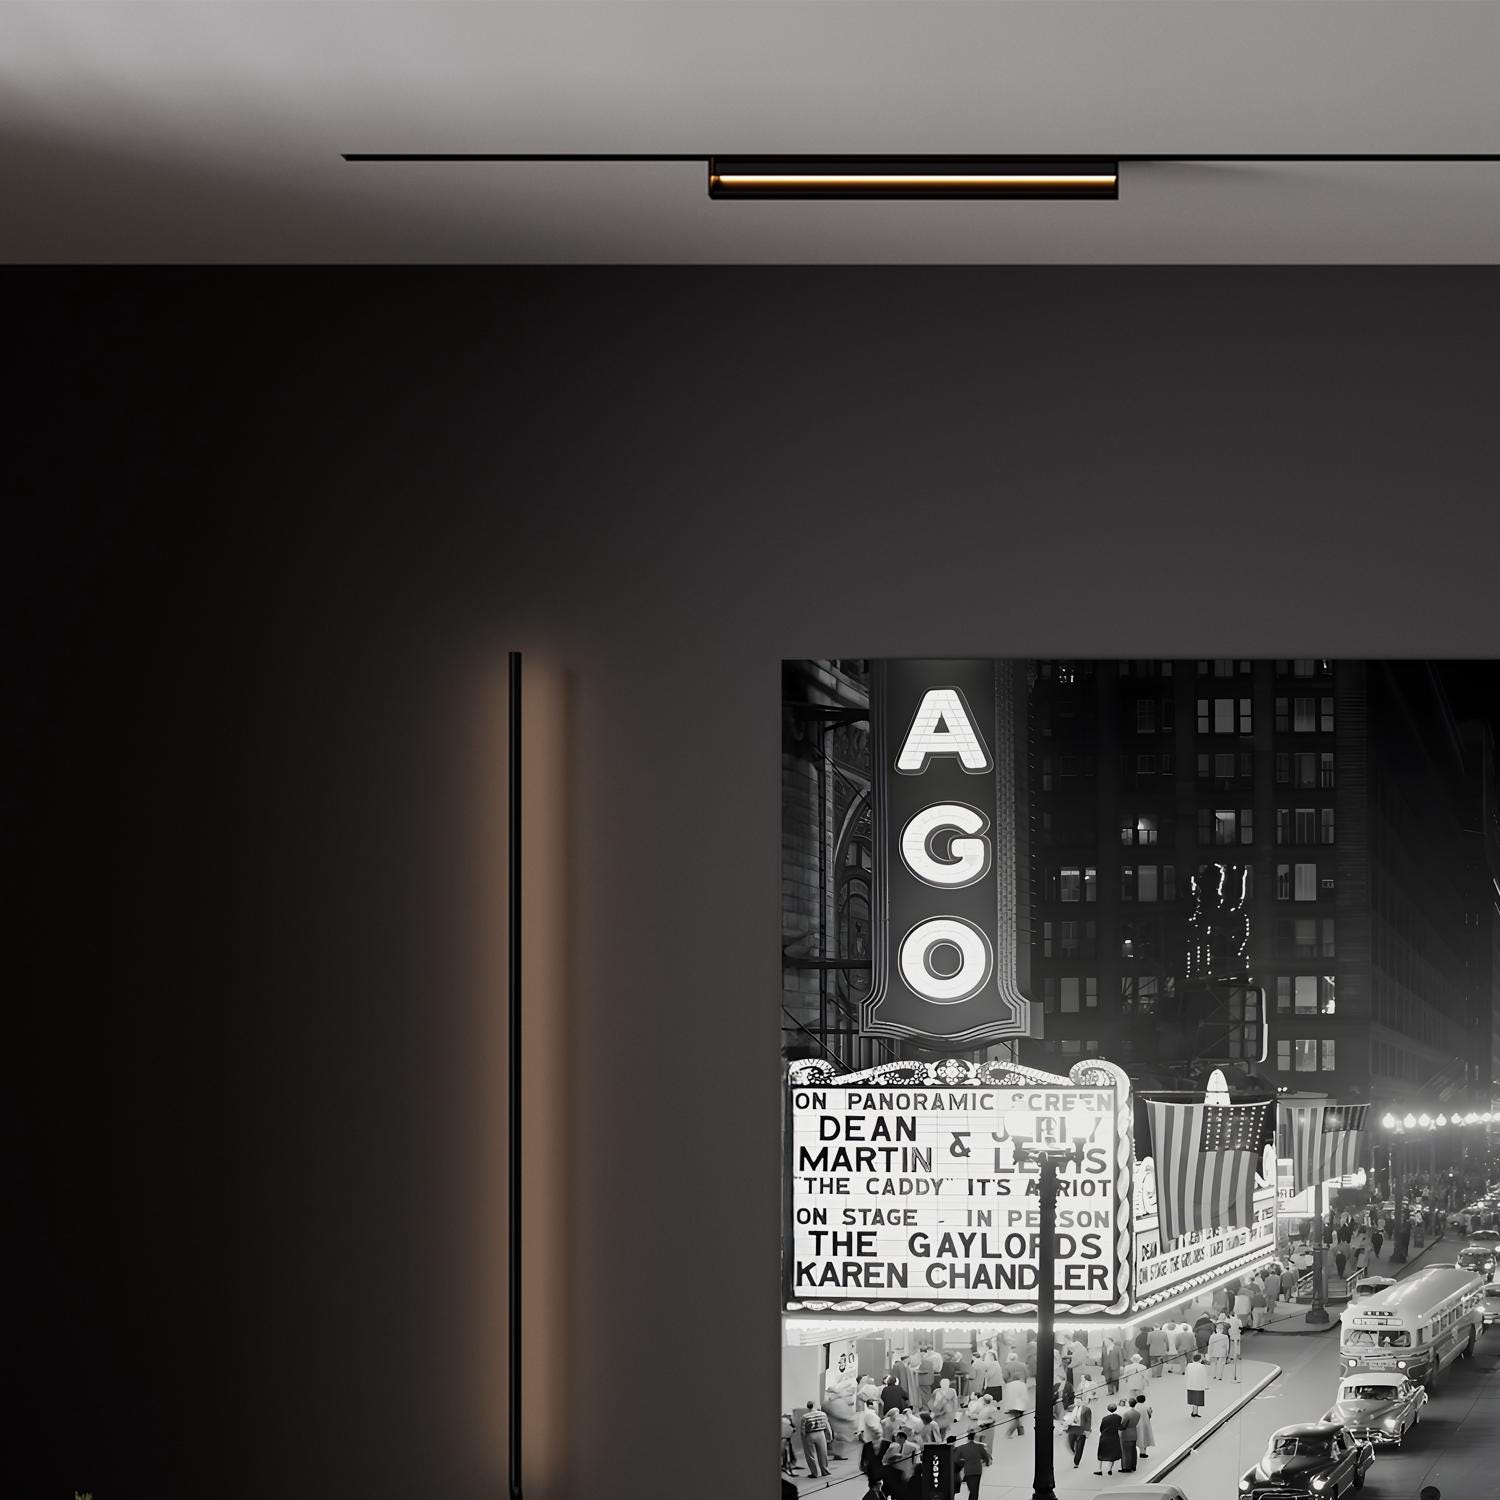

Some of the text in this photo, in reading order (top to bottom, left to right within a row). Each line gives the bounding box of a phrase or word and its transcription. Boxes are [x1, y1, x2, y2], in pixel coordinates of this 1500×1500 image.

[795, 1092, 827, 1110] ON
[848, 1092, 995, 1111] PANORAMIC
[819, 1115, 917, 1142] DEAN
[949, 1131, 972, 1158] &
[799, 1145, 932, 1173] MARTIN
[967, 1178, 1012, 1196] IT'S
[796, 1207, 827, 1226] ON
[842, 1208, 918, 1227] STAGE
[967, 1209, 992, 1227] IN
[1007, 1210, 1110, 1229] PESON
[808, 1230, 878, 1257] THE
[796, 1261, 908, 1288] KAREN
